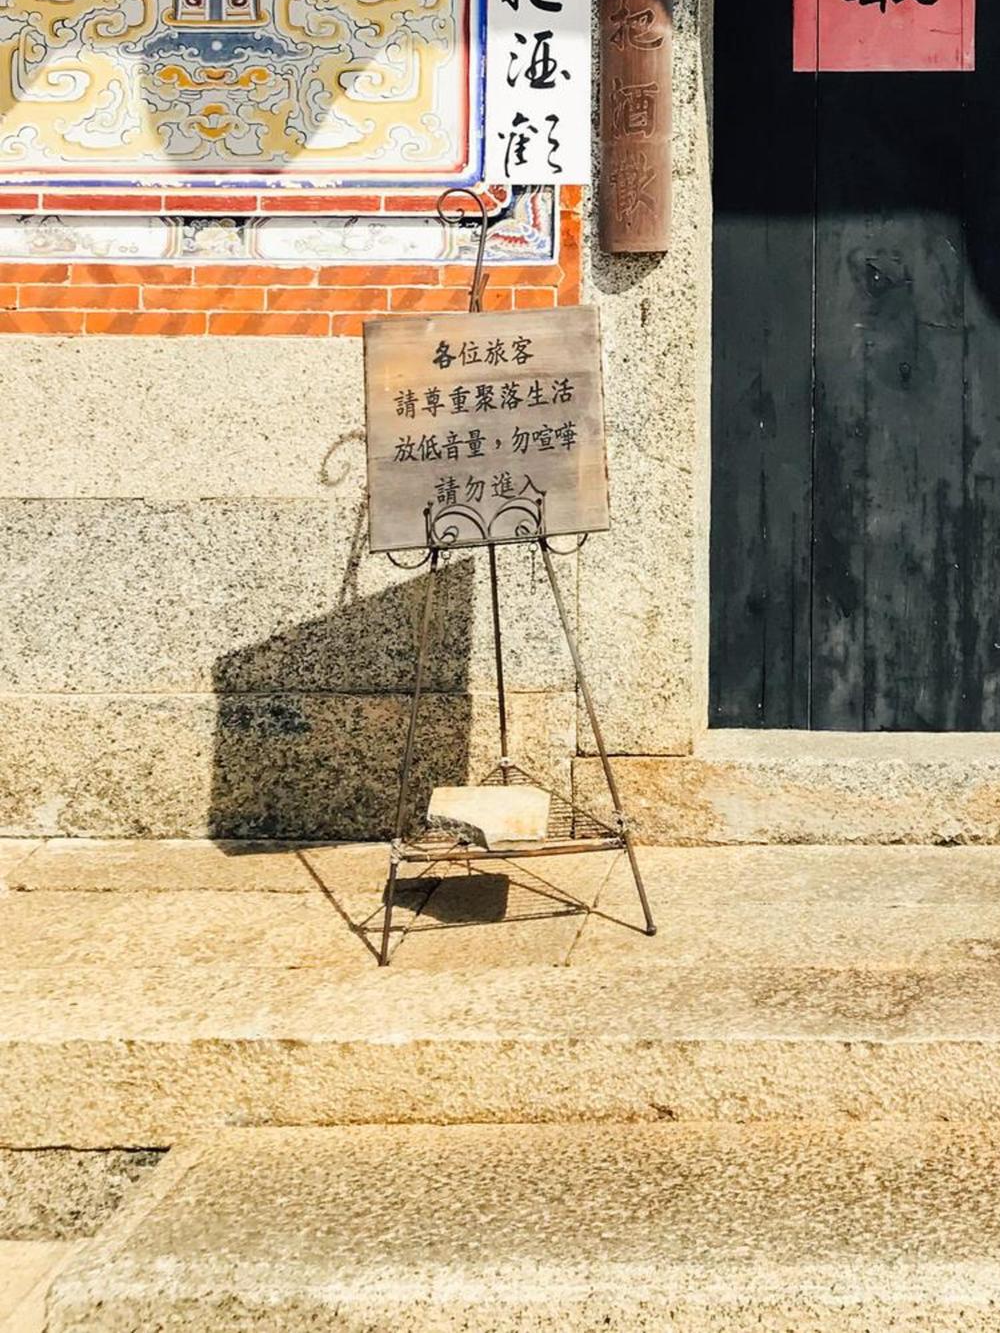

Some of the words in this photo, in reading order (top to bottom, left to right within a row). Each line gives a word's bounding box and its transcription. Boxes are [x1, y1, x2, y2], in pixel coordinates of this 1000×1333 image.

[432, 336, 535, 369] 各位旅客
[393, 377, 576, 419] 請尊重聚落生活
[434, 470, 547, 506] 請勿進入
